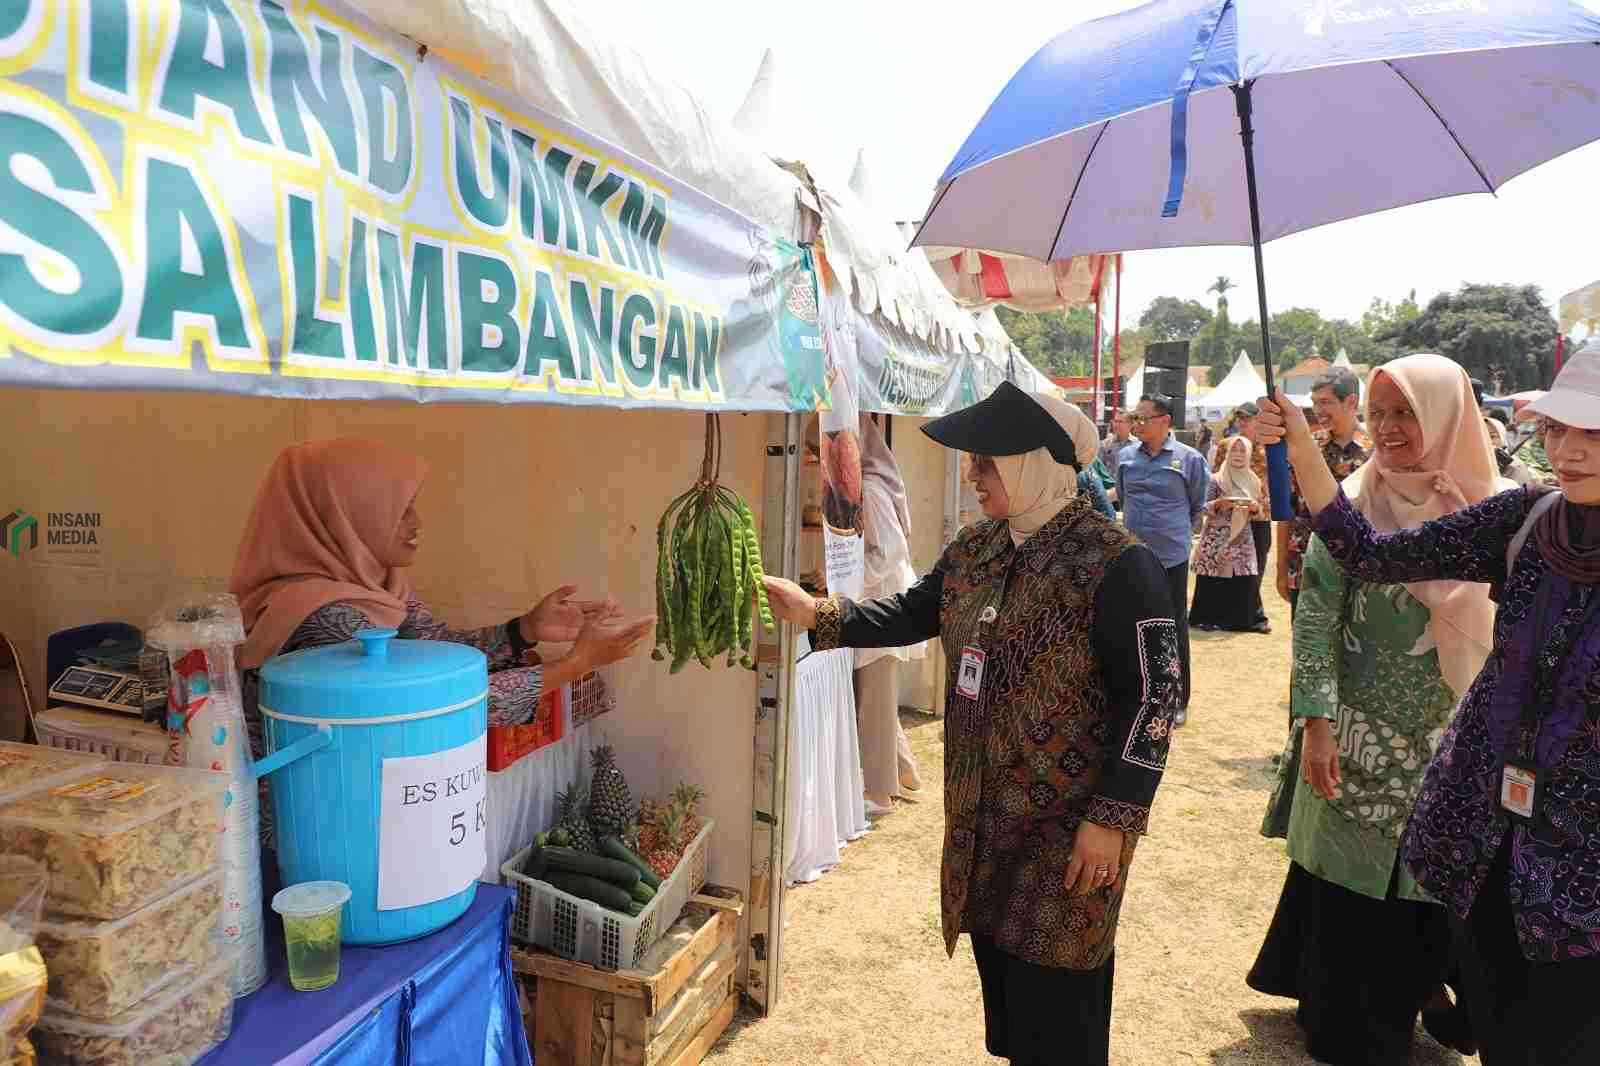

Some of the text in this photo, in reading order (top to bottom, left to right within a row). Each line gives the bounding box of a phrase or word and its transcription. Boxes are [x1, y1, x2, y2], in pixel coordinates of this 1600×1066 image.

[0, 0, 666, 281] AND UMKM
[286, 192, 722, 393] LIMBANGAN
[401, 765, 482, 805] ES KUW
[449, 811, 467, 846] 5
